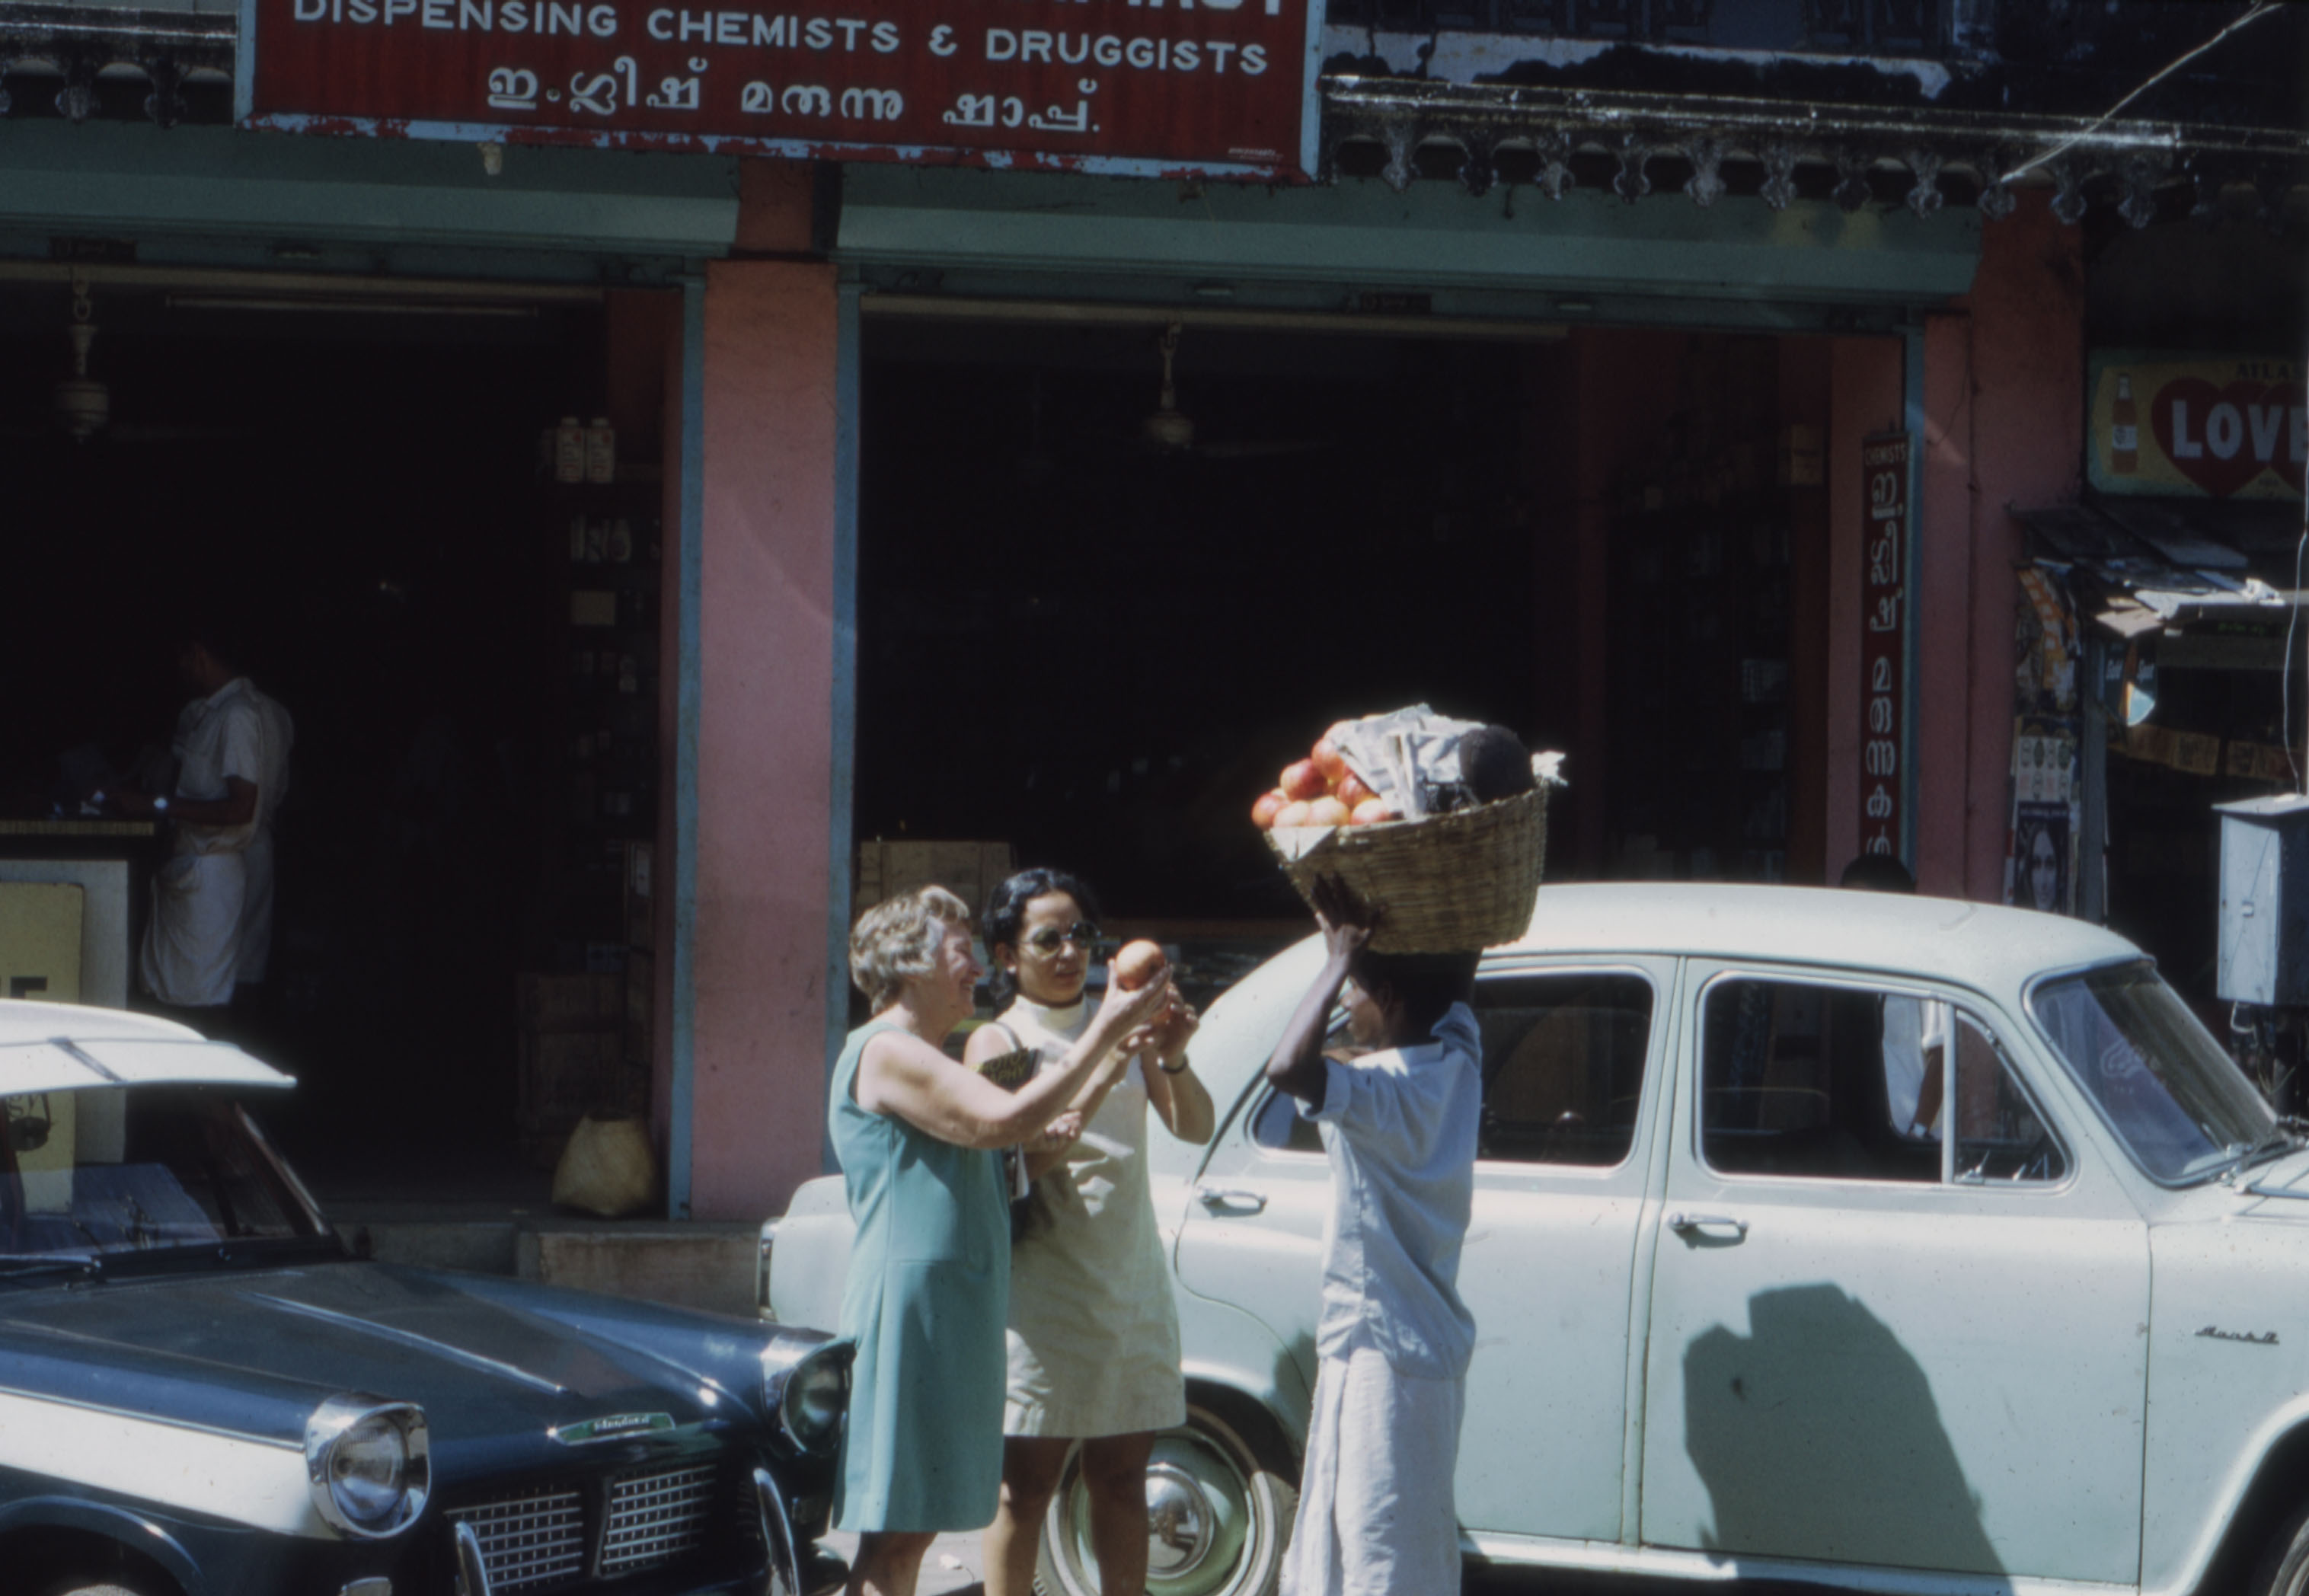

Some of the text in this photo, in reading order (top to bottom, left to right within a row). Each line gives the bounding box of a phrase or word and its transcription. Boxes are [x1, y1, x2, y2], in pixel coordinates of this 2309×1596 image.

[294, 0, 1267, 75] DISPENSING CHEMISTS & DRUGGISTS
[2237, 363, 2299, 378] ATLA
[1866, 444, 1907, 466] CHEMISTS
